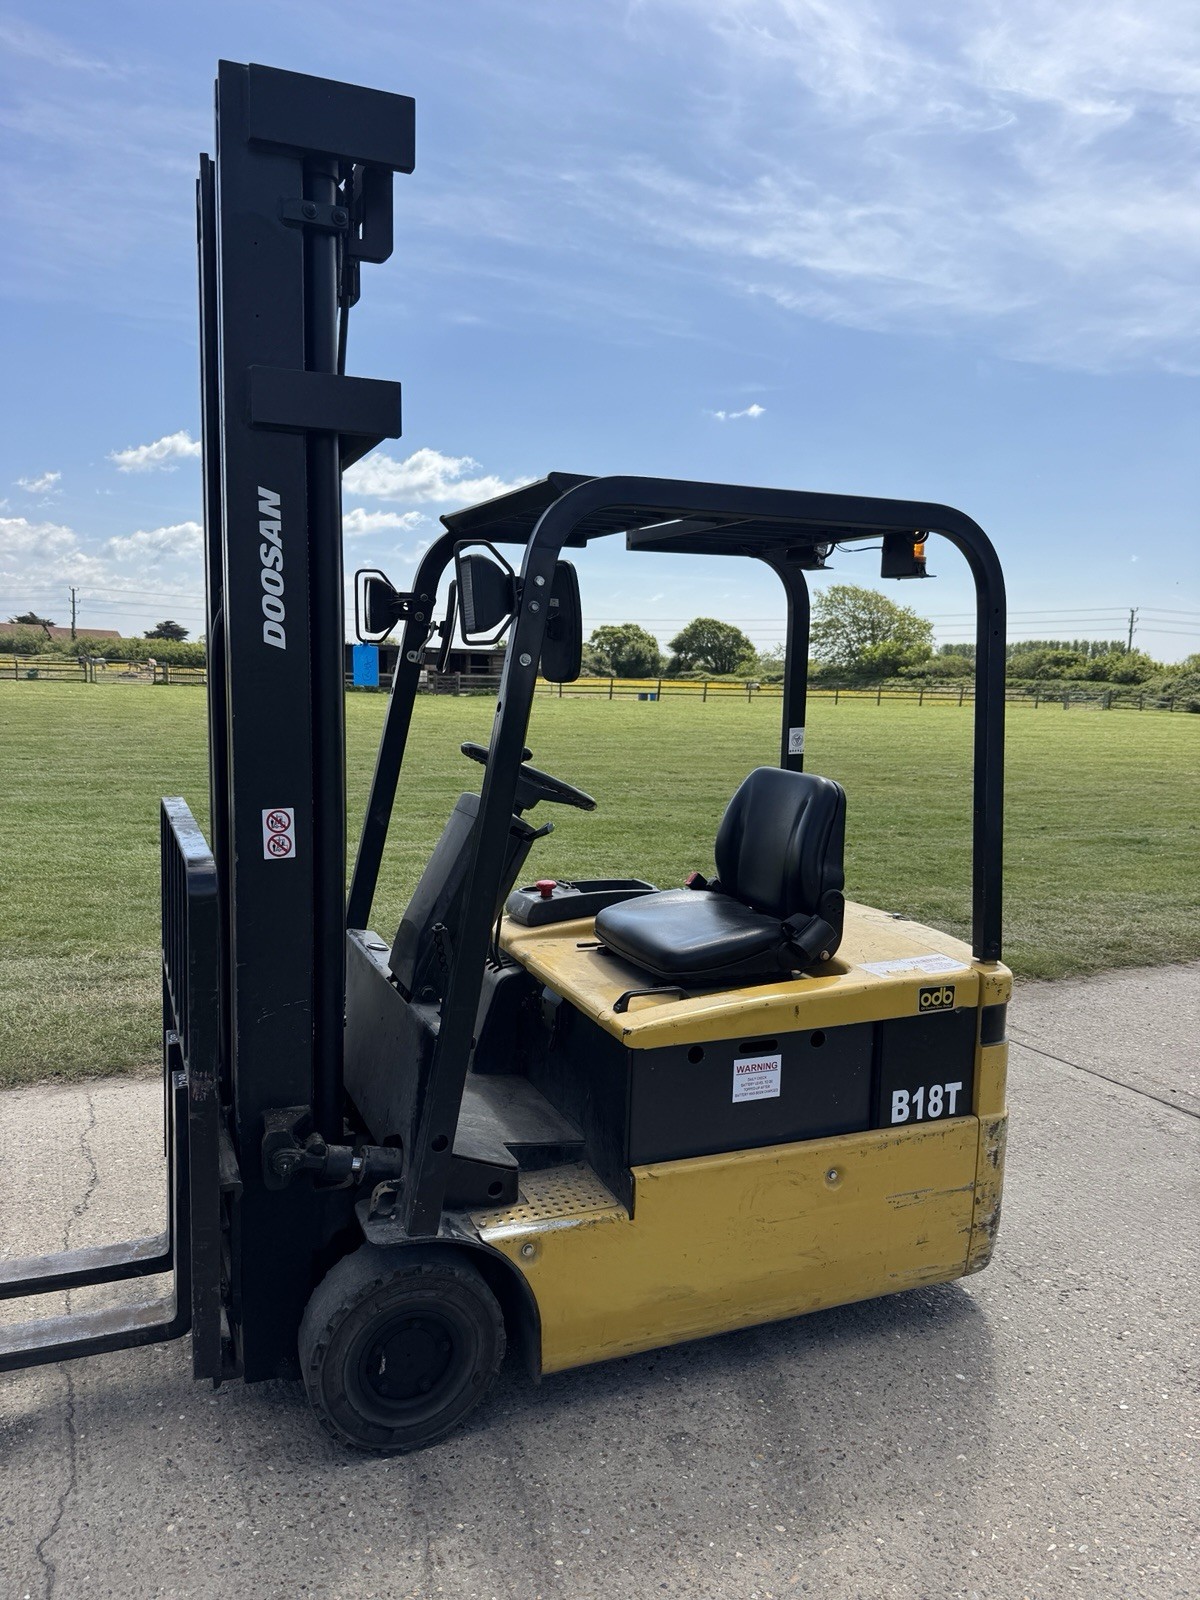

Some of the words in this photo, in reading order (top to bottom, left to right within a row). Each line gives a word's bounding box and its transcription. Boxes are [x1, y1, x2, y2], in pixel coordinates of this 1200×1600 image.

[257, 485, 287, 650] DOOSAN
[920, 987, 953, 1006] odb
[736, 1061, 778, 1073] WARNING
[891, 1082, 962, 1123] B18T
